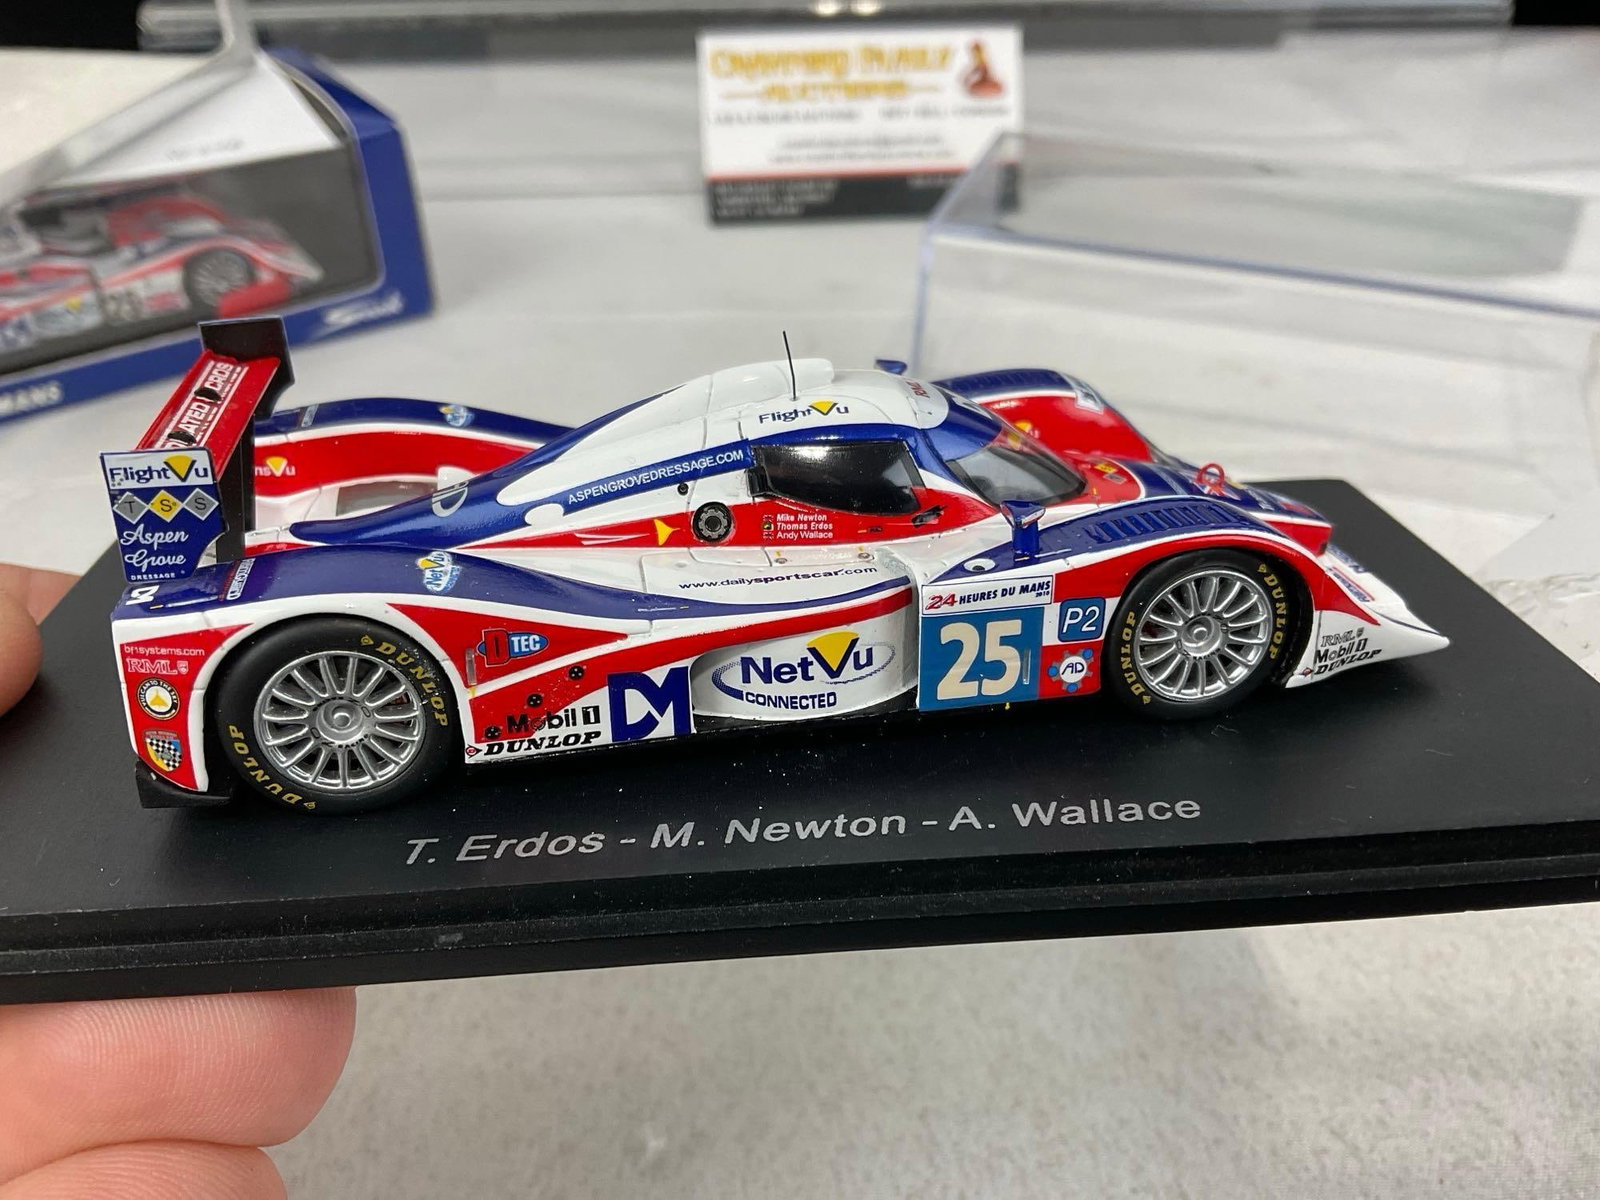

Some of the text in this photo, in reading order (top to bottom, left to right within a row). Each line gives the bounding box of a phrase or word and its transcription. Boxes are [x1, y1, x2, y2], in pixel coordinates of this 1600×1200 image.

[759, 400, 849, 424] FlightVu
[109, 455, 208, 483] FlightVu
[568, 449, 744, 504] ASPENGROVEDRESSAGE.COM
[776, 513, 827, 522] Mike Newton
[776, 522, 833, 531] Thomas Erdos
[120, 523, 188, 550] Aspen
[776, 530, 833, 540] Andy Wallace
[124, 550, 186, 573] Grove
[131, 571, 176, 581] DRESSAGE
[679, 566, 877, 590] www.dailysportscar.com
[925, 580, 1050, 611] 24 HEURES DU MANS
[1062, 606, 1100, 633] P2
[1265, 574, 1287, 660] DUNLOP
[126, 657, 178, 675] RML
[740, 632, 874, 684] NetVu
[937, 619, 1022, 701] 25
[1119, 611, 1146, 698] DUNLOP
[1314, 642, 1355, 664] Mobil
[1314, 649, 1382, 675] DUNLOP
[376, 640, 449, 728] DUNLOP
[745, 690, 837, 710] CONNECTED
[506, 709, 577, 734] Mobil
[483, 731, 602, 755] DUNLOP
[229, 725, 303, 805] DUNLOP
[406, 838, 435, 865] T.
[456, 831, 606, 863] Erdos
[650, 821, 705, 849] M.
[724, 813, 907, 845] Newton
[948, 805, 996, 832] A.
[1011, 799, 1201, 828] Wallace
